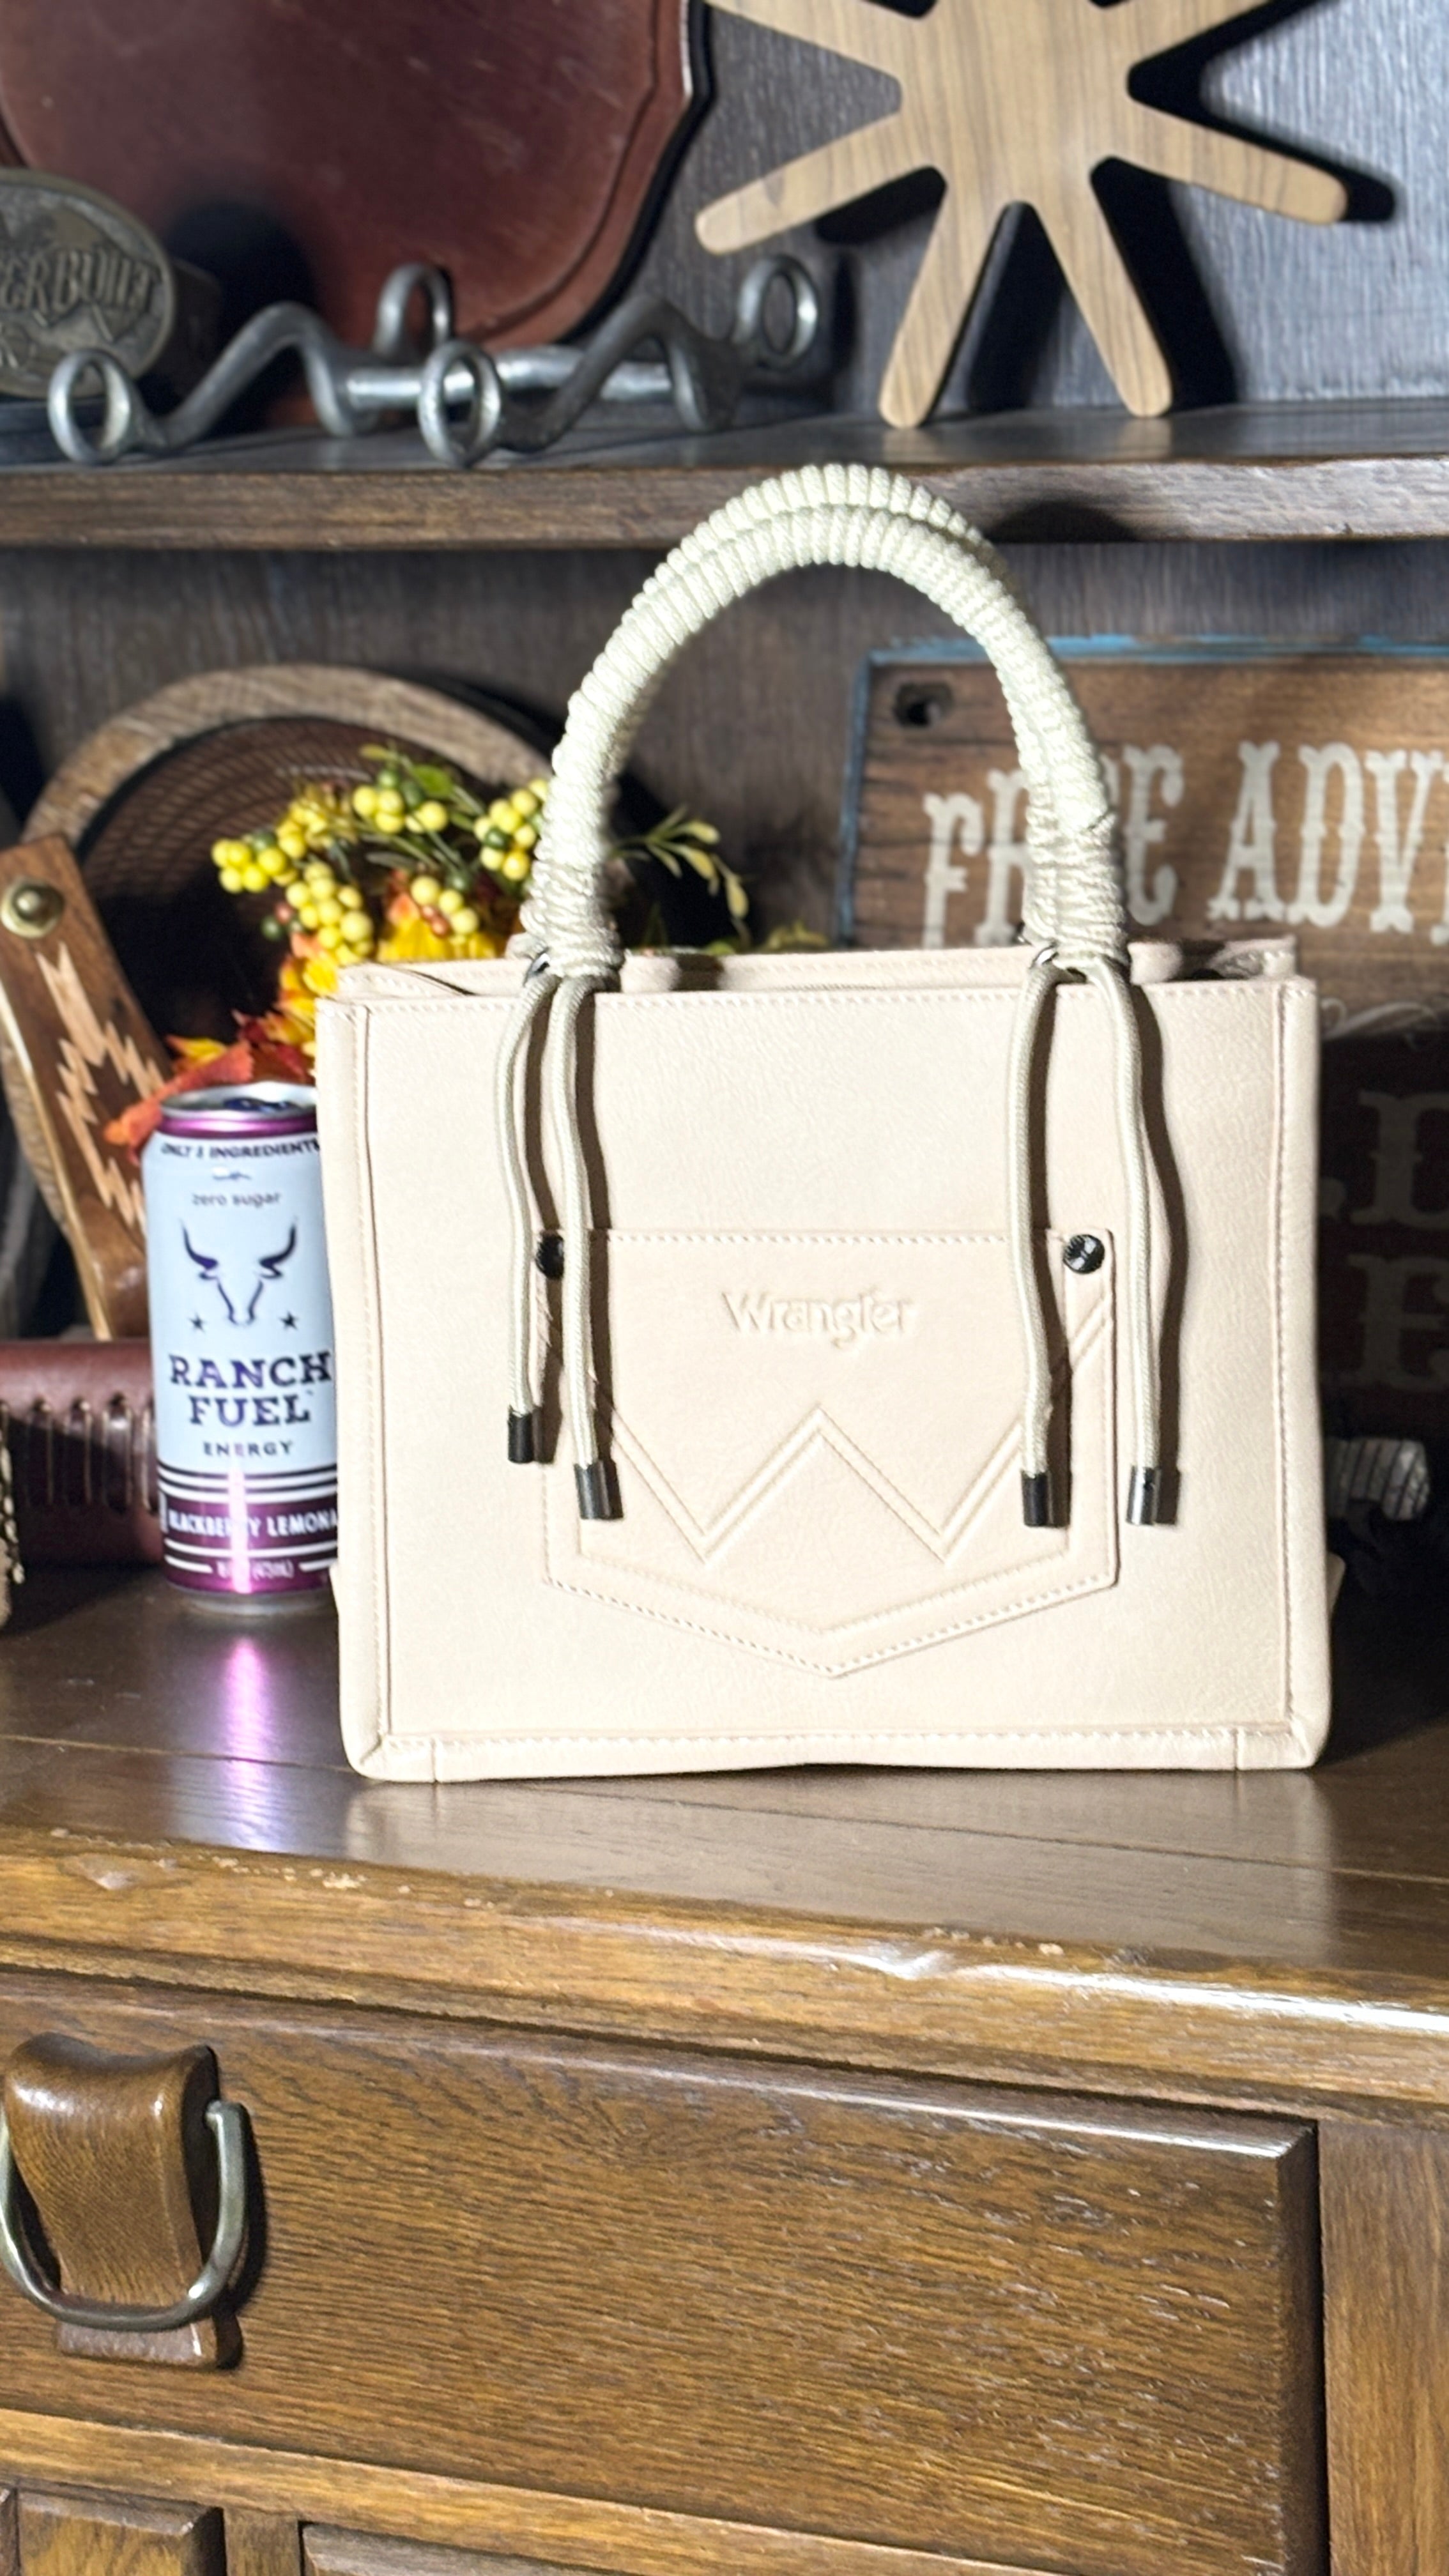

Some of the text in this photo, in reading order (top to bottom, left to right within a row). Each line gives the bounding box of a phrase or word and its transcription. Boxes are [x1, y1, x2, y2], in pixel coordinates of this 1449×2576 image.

[1206, 740, 1449, 946] ADV
[192, 1192, 281, 1208] zero sugar
[721, 1284, 915, 1351] Wrangler
[169, 1351, 332, 1389] RANCH
[189, 1395, 311, 1427] FUEL
[204, 1440, 293, 1457] ENERGY
[169, 1510, 261, 1538] BLACKBERY
